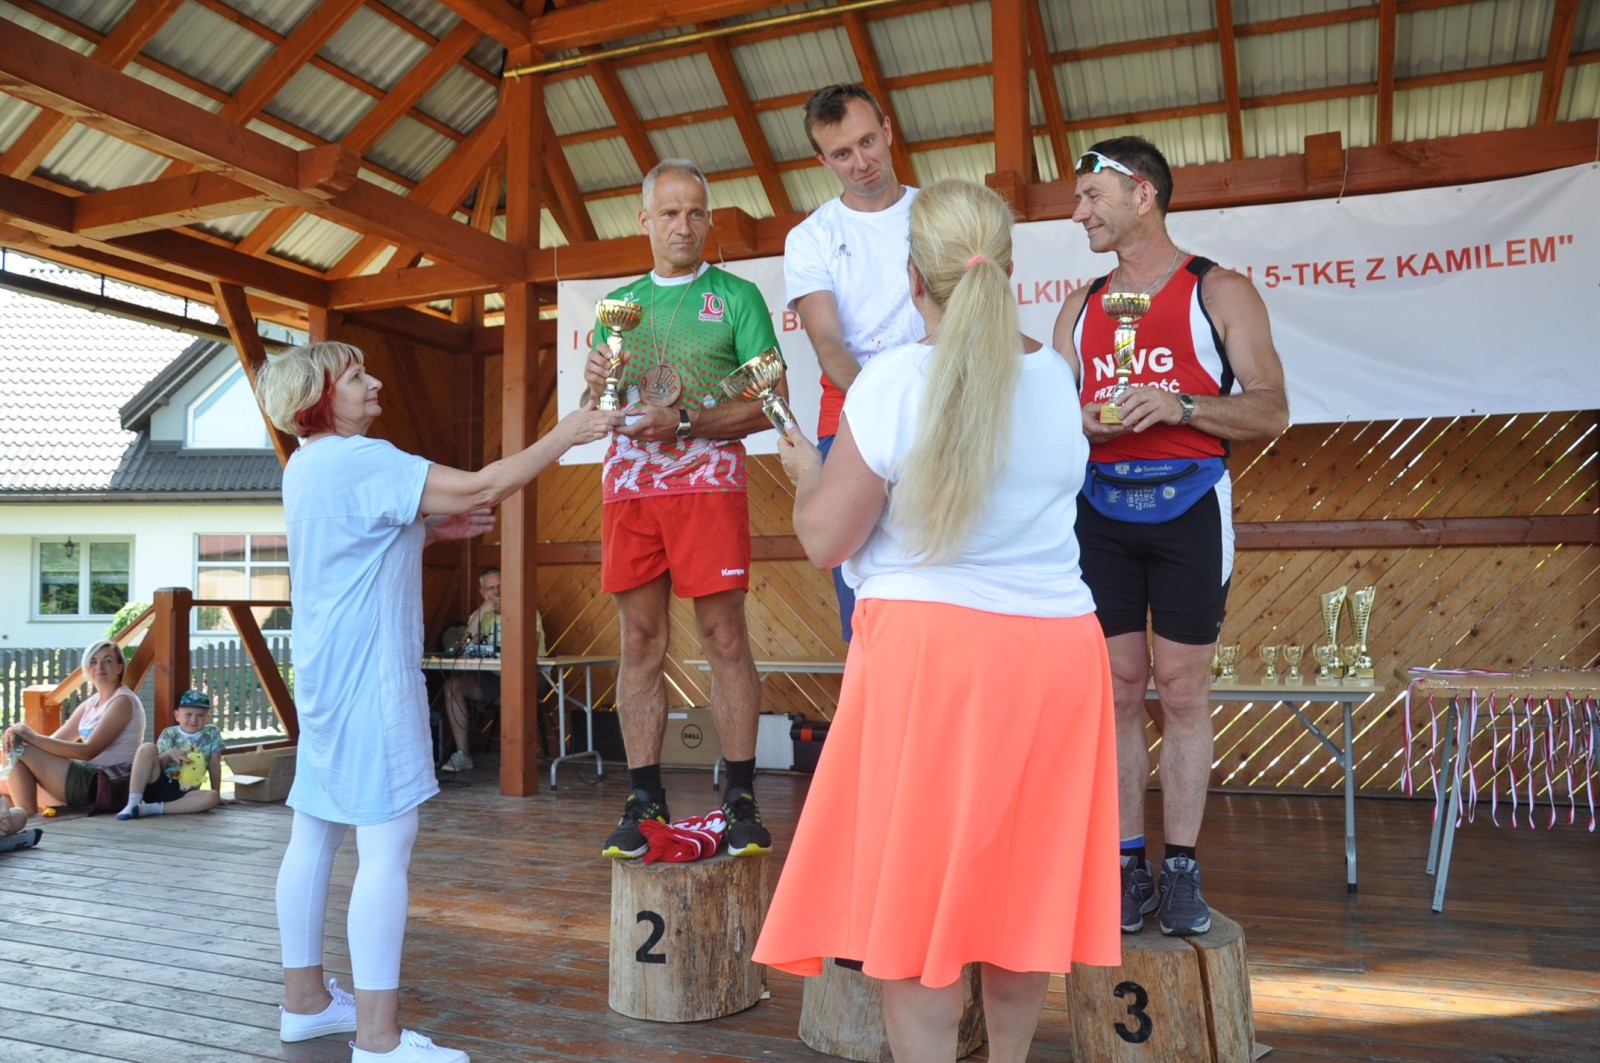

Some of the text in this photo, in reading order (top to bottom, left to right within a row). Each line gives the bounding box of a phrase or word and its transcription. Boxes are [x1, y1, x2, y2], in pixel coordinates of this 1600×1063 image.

[1264, 260, 1356, 288] 5-TKĘ
[1365, 257, 1387, 281] Z
[1396, 234, 1574, 279] KAMILEM"
[1143, 464, 1173, 472] Santander
[683, 732, 701, 740] DELL
[635, 910, 667, 964] 2
[1113, 981, 1153, 1043] 3
